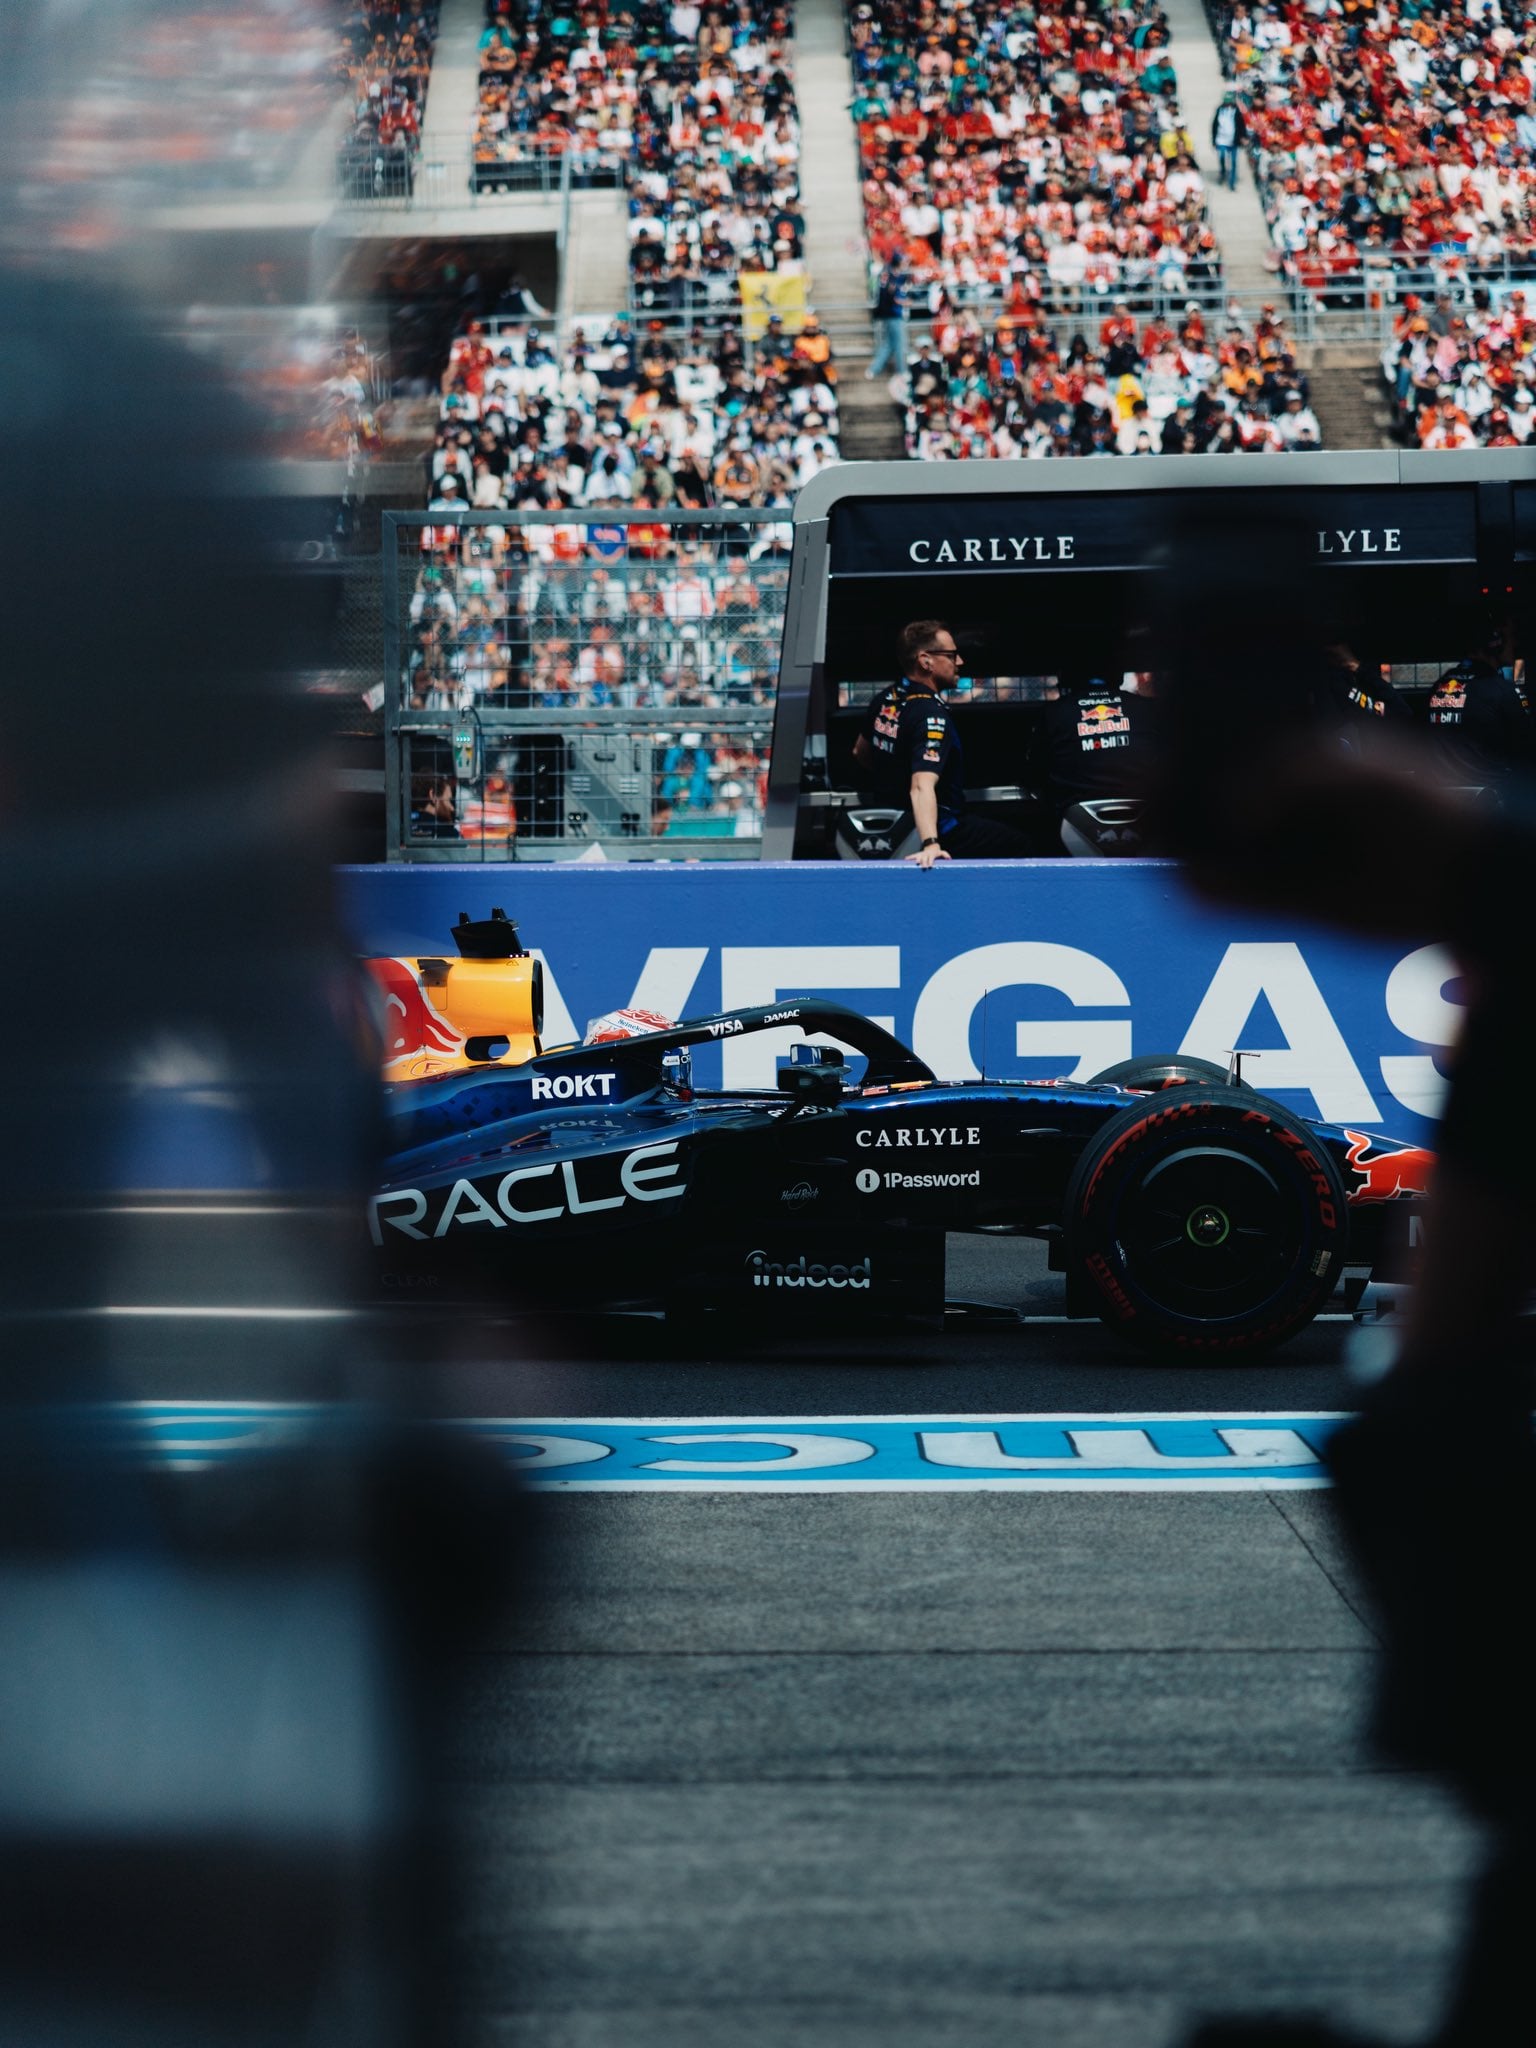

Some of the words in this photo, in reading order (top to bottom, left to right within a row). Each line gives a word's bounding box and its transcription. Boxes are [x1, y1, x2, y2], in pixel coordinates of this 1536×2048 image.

[909, 536, 1075, 563] CARLYLE
[1077, 719, 1104, 736] Red
[1104, 717, 1130, 733] Bull
[1082, 736, 1116, 751] Mobil
[764, 1009, 800, 1023] DAMAC
[707, 1019, 744, 1036] VISA
[532, 1074, 616, 1100] ROKT
[856, 1127, 981, 1148] CARLYLE
[884, 1170, 980, 1188] 1Password
[1273, 1127, 1337, 1230] ZERO
[745, 1249, 871, 1289] indeed
